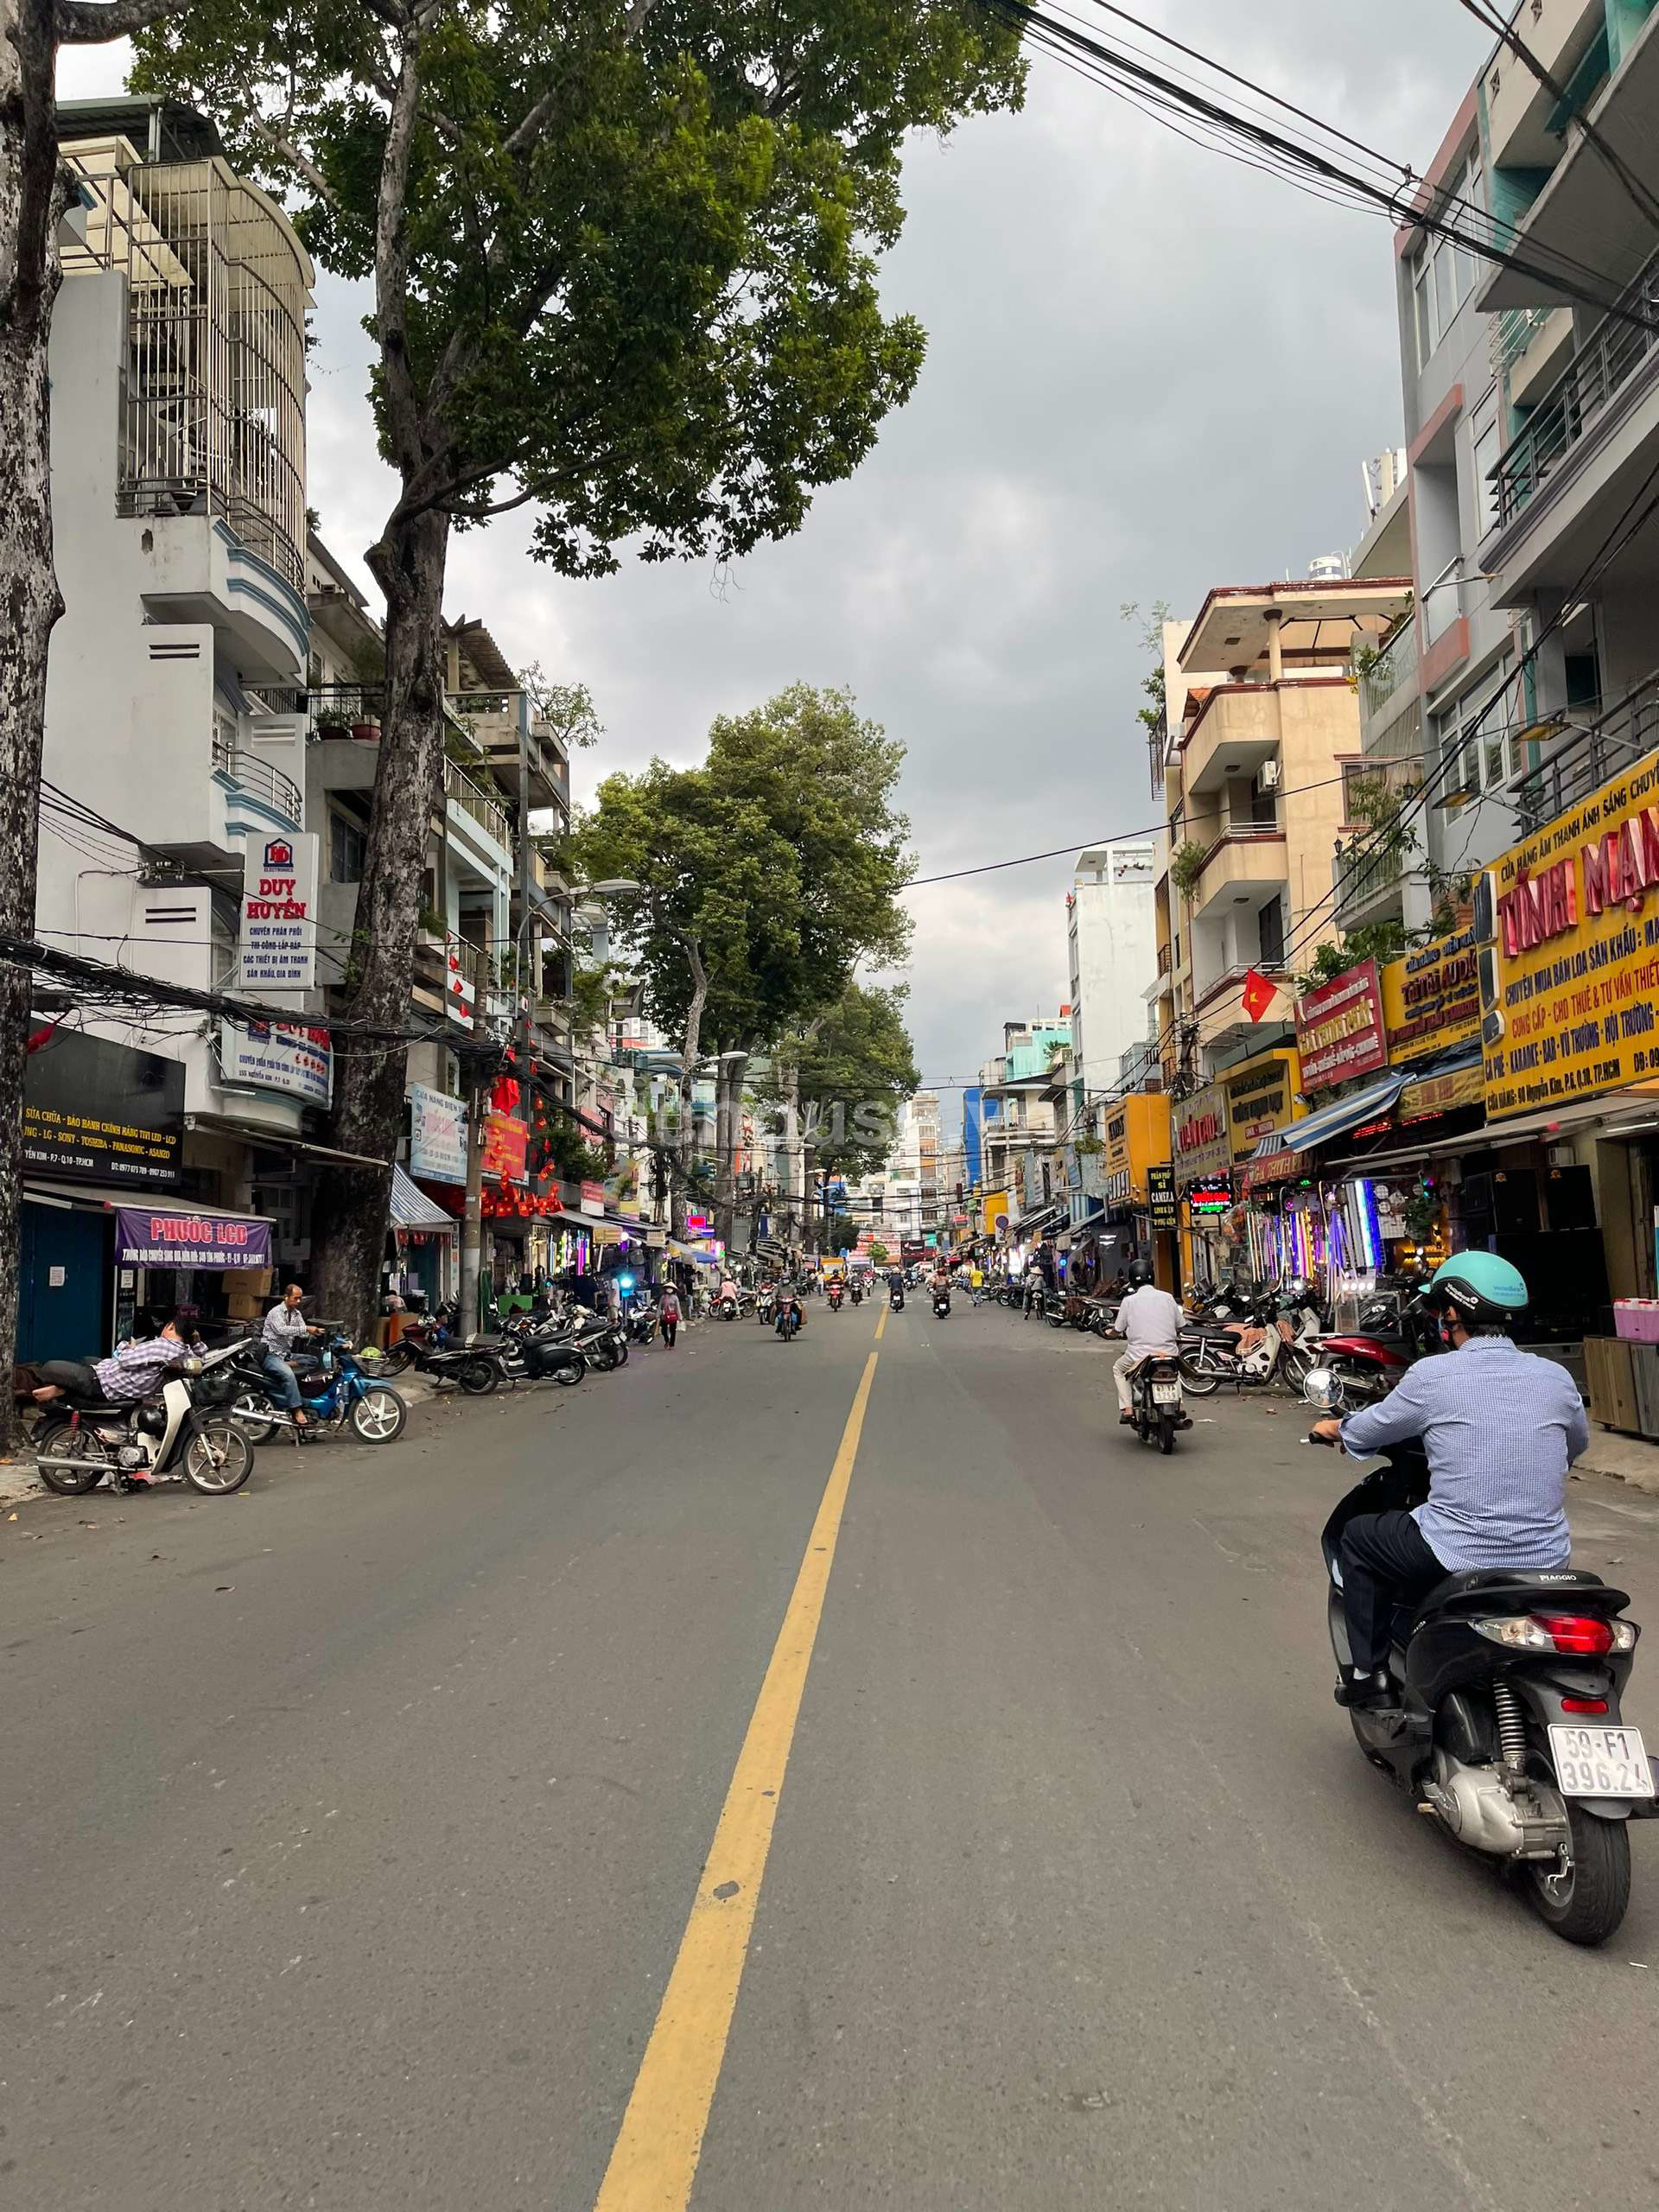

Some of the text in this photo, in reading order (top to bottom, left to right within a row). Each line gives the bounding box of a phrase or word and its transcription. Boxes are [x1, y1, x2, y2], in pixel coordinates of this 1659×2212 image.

[1516, 846, 1537, 871] HÀNG
[1540, 837, 1551, 857] ÂM
[1554, 823, 1580, 848] THANH
[1582, 808, 1600, 832] ÁNH
[1603, 788, 1626, 817] SÁNG
[1630, 760, 1659, 800] CHUY
[259, 880, 296, 896] DUY
[250, 926, 270, 936] CHUYÊN
[272, 926, 287, 936] PHÂN
[262, 941, 276, 950] CÔNG
[244, 955, 253, 963] CÁC
[279, 955, 289, 963] ÂM
[1506, 974, 1533, 1007] CHUYÊN
[1535, 966, 1552, 994] MUA
[1554, 957, 1571, 987] BÁN
[1571, 951, 1588, 978] LOA
[1590, 938, 1607, 970] SÂN
[1512, 1013, 1530, 1038] CUNG
[1554, 999, 1568, 1024] CHO
[1571, 985, 1592, 1017] THUÊ
[1593, 987, 1599, 1007] &
[1600, 977, 1613, 1005] TƯ
[1615, 968, 1632, 1000] VẤN
[1620, 1000, 1654, 1037] TRƯỜNG
[1593, 1058, 1620, 1084] TP.HCM
[43, 1129, 52, 1139] LG
[58, 1132, 76, 1143] SONY
[81, 1136, 107, 1149] TOSHIBA
[112, 1141, 145, 1154] PANASONIC
[139, 1130, 150, 1140] TIVI
[166, 1135, 176, 1145] LCD
[1151, 1192, 1174, 1203] CAMERA
[217, 1224, 248, 1245] LCD
[1564, 1730, 1630, 1760] 59-F1
